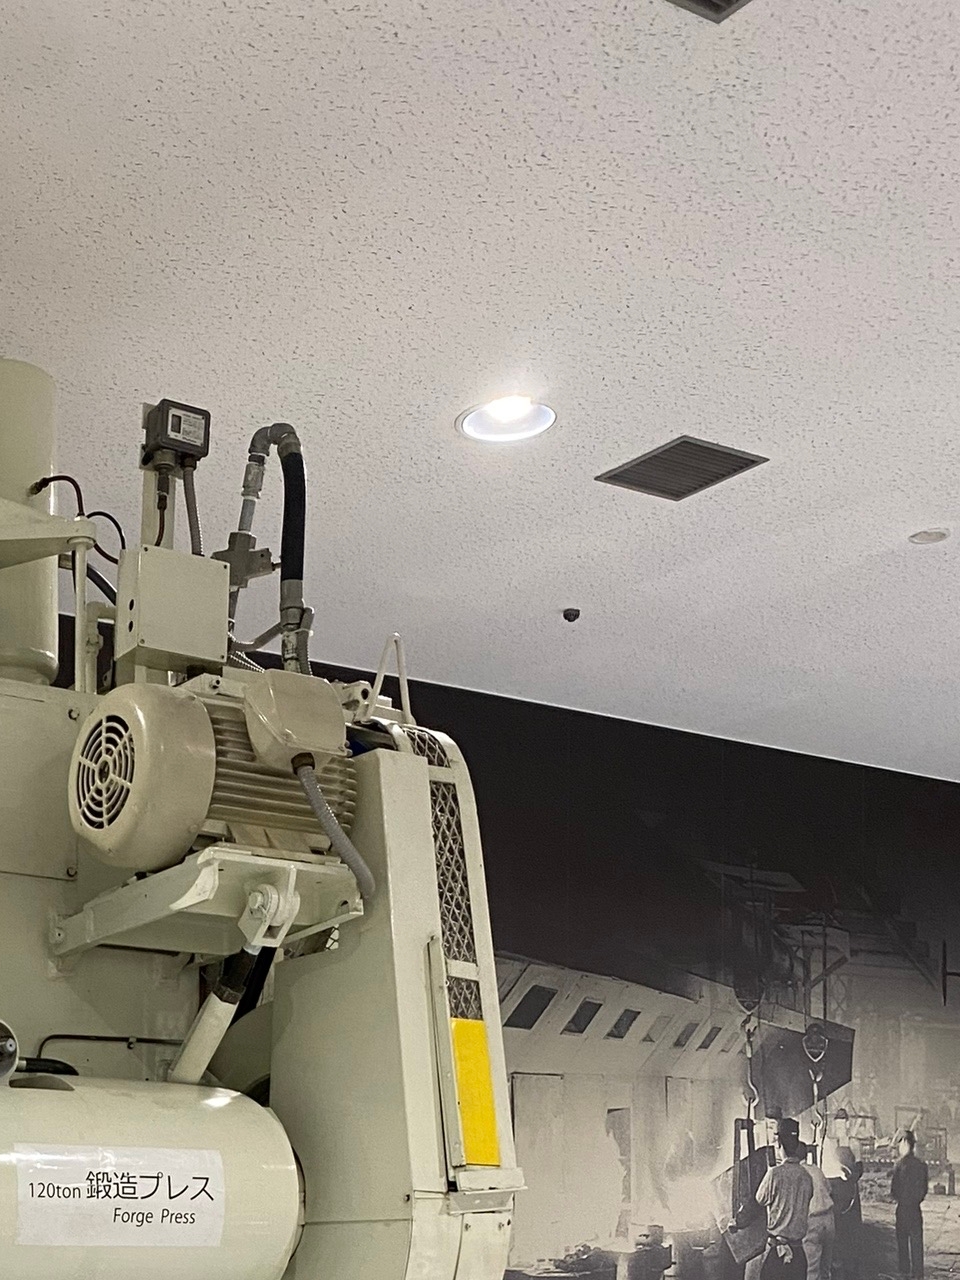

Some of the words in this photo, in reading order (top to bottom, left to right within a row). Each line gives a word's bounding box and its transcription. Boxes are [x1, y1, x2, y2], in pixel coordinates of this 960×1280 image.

[28, 1181, 82, 1199] 120ton
[85, 1170, 215, 1202] 鍛造プレス
[113, 1207, 154, 1227] Forge
[160, 1208, 196, 1224] Press
